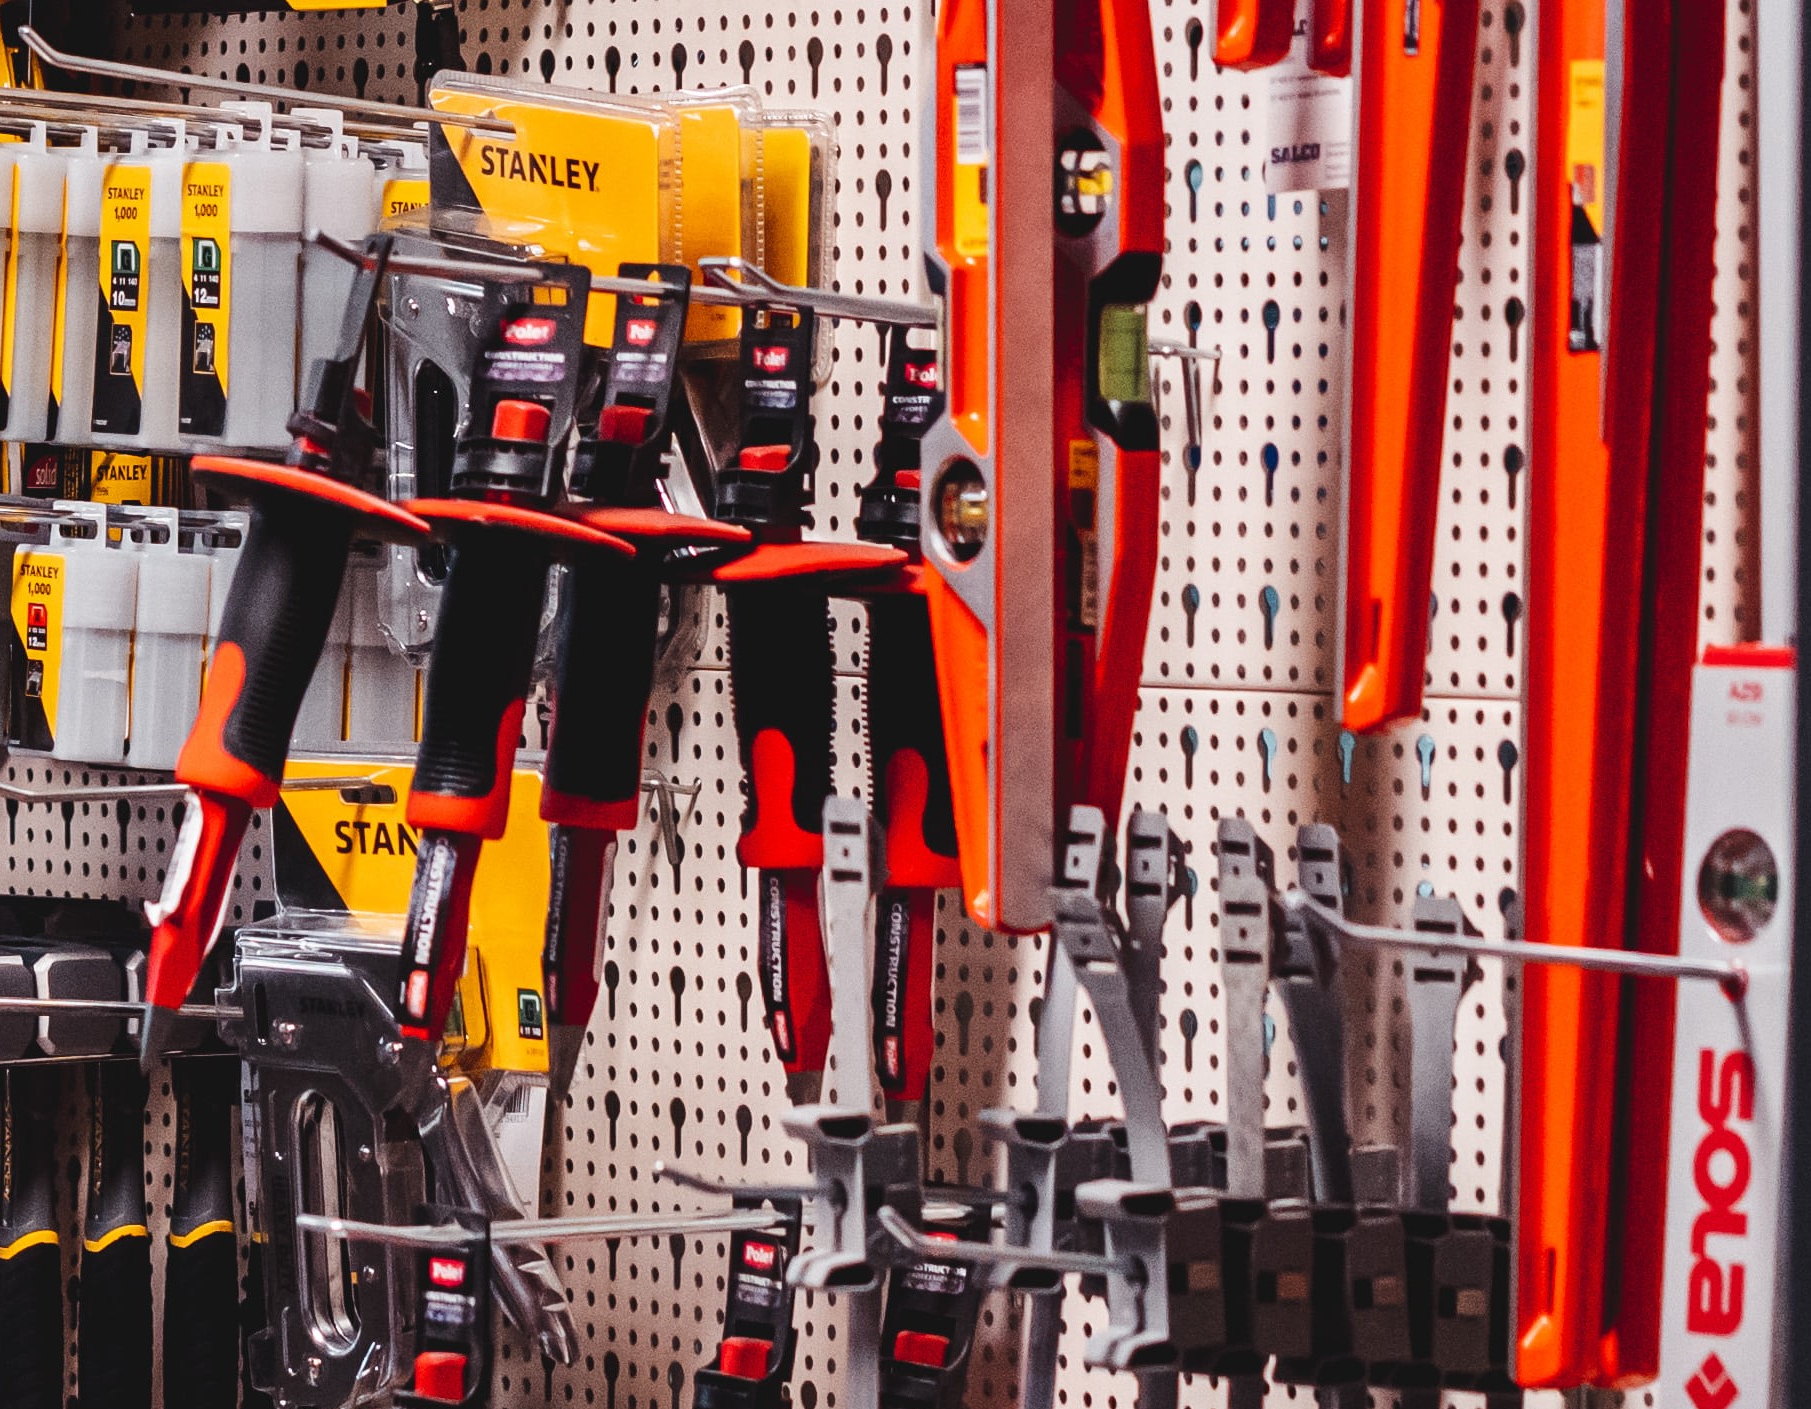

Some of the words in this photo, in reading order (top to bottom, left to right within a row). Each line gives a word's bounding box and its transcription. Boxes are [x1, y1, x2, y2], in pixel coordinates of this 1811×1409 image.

[1270, 142, 1321, 165] SALCO
[481, 144, 600, 192] STANLEY
[108, 186, 145, 201] STANLEY
[187, 184, 224, 198] STANLEY
[114, 206, 138, 222] 1,000
[194, 203, 218, 218] 1,000
[35, 457, 59, 486] solid
[96, 464, 148, 482] STANLEY
[20, 563, 59, 580] STANLEY
[27, 582, 52, 597] 1,000
[334, 820, 419, 857] STAN
[770, 876, 784, 1003] CONSTRUCTION
[885, 902, 903, 1029] CONSTRUCTION
